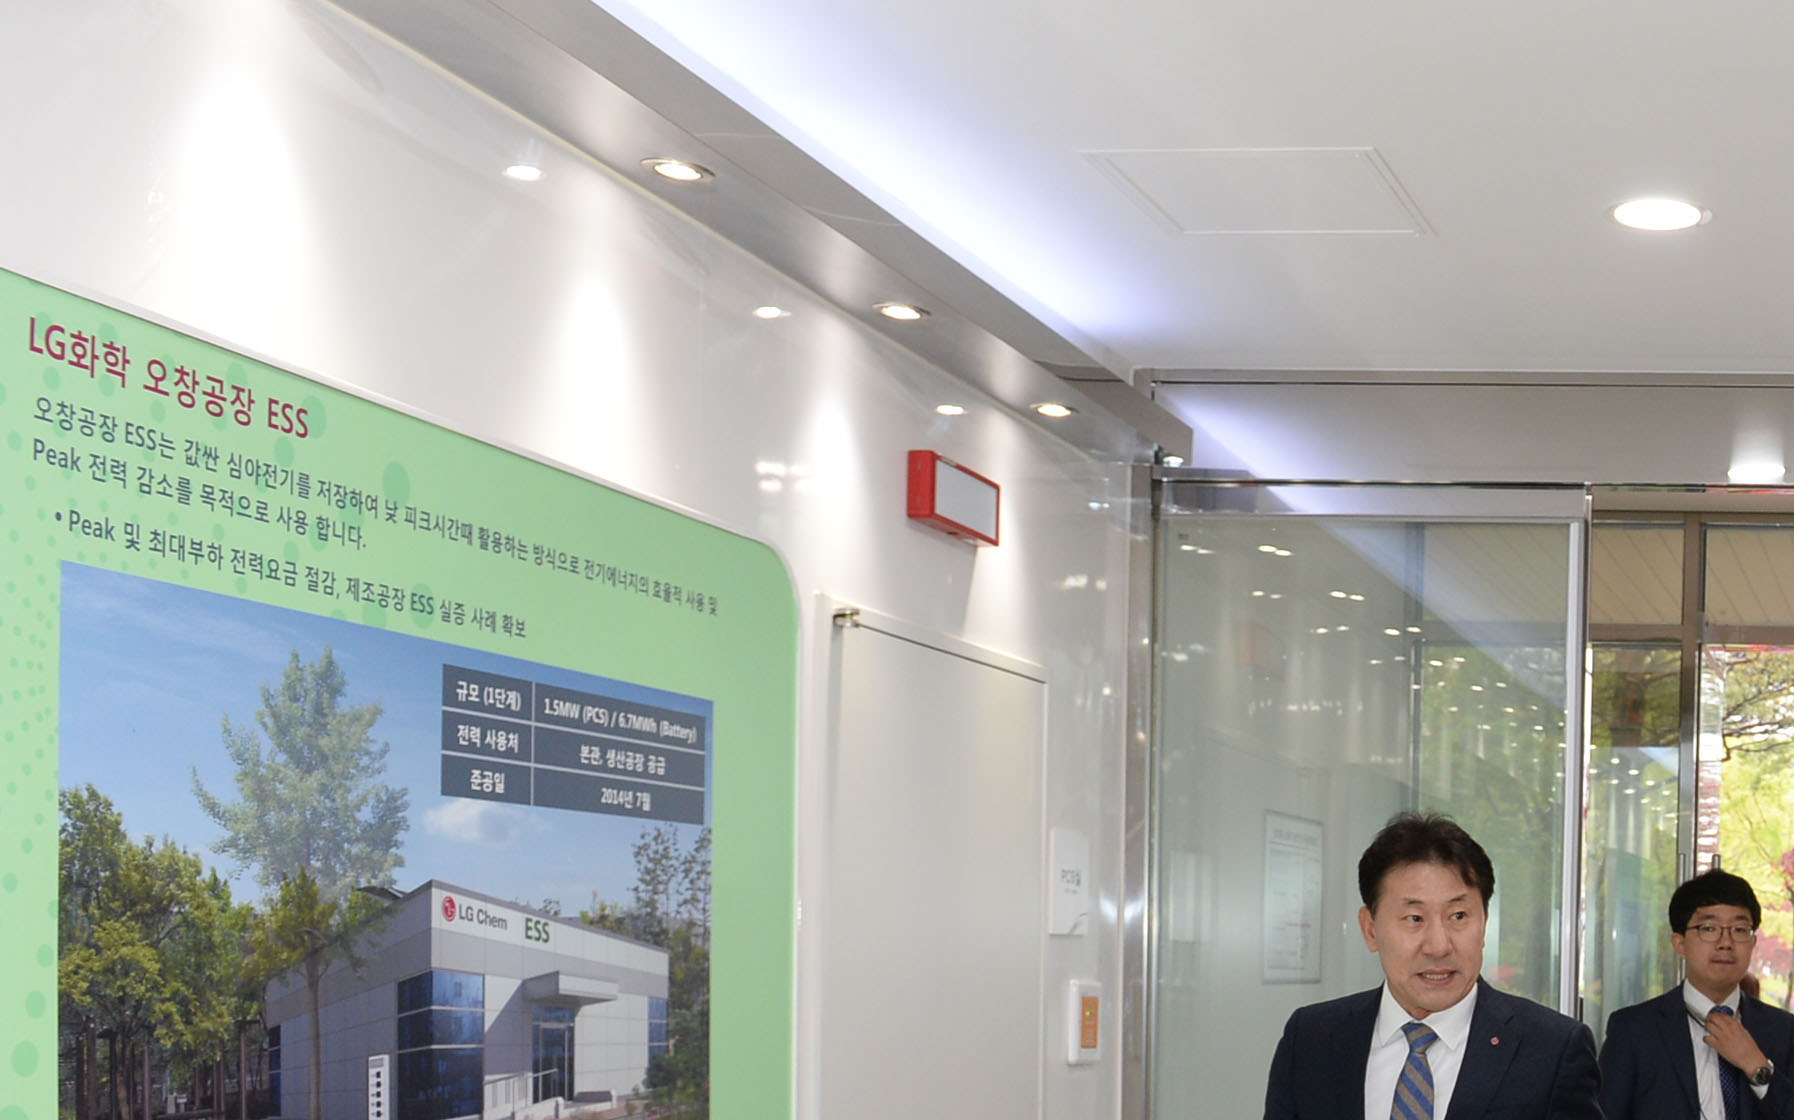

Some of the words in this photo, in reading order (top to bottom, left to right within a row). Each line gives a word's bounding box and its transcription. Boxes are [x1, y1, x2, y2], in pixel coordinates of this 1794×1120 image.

[28, 316, 131, 388] LG화학
[143, 359, 255, 427] 오창공장
[267, 397, 309, 438] ESS
[33, 438, 81, 473] Peak
[89, 453, 127, 489] 전력
[136, 465, 192, 506] 감소를
[200, 483, 270, 524] 목적으로
[276, 506, 309, 535] 사용
[315, 515, 367, 550] 합니다.
[33, 396, 118, 443] 오창공장
[124, 421, 176, 460] ESS는
[183, 439, 220, 473] 값싼
[226, 453, 312, 500] 심야전기를
[317, 480, 379, 519] 저장하여
[384, 499, 398, 523] 낮
[404, 506, 473, 546] 피크시간때
[477, 527, 529, 561] 활용하는
[533, 544, 580, 574] 방식으로
[584, 559, 649, 596] 전기에너지의
[652, 580, 682, 605] 효율적
[685, 591, 704, 613] 사용
[69, 509, 115, 542] Peak
[124, 522, 140, 551] 및
[148, 528, 224, 570] 최대부하
[230, 548, 298, 587] 전력요금
[304, 566, 340, 599] 절감,
[345, 576, 405, 612] 제조공장
[410, 592, 434, 615] ESS
[440, 600, 466, 625] 실증
[471, 607, 496, 633] 사례
[502, 614, 526, 638] 확보
[456, 680, 480, 702] 규모
[483, 686, 522, 712] (1단계)
[543, 698, 580, 720] 1.5MW
[582, 705, 608, 727] (PCS)
[618, 712, 657, 733] 6.7MWh
[659, 720, 697, 744] (Battery)
[457, 724, 480, 747] 전력
[484, 729, 518, 753] 사용처
[606, 749, 644, 772] 생산공장
[647, 755, 666, 775] 공급
[470, 769, 505, 794] 준공일
[601, 787, 633, 809] 2014년
[636, 792, 651, 811] 7월
[459, 904, 474, 922] LG
[477, 909, 508, 930] Chem
[525, 917, 550, 943] ESS
